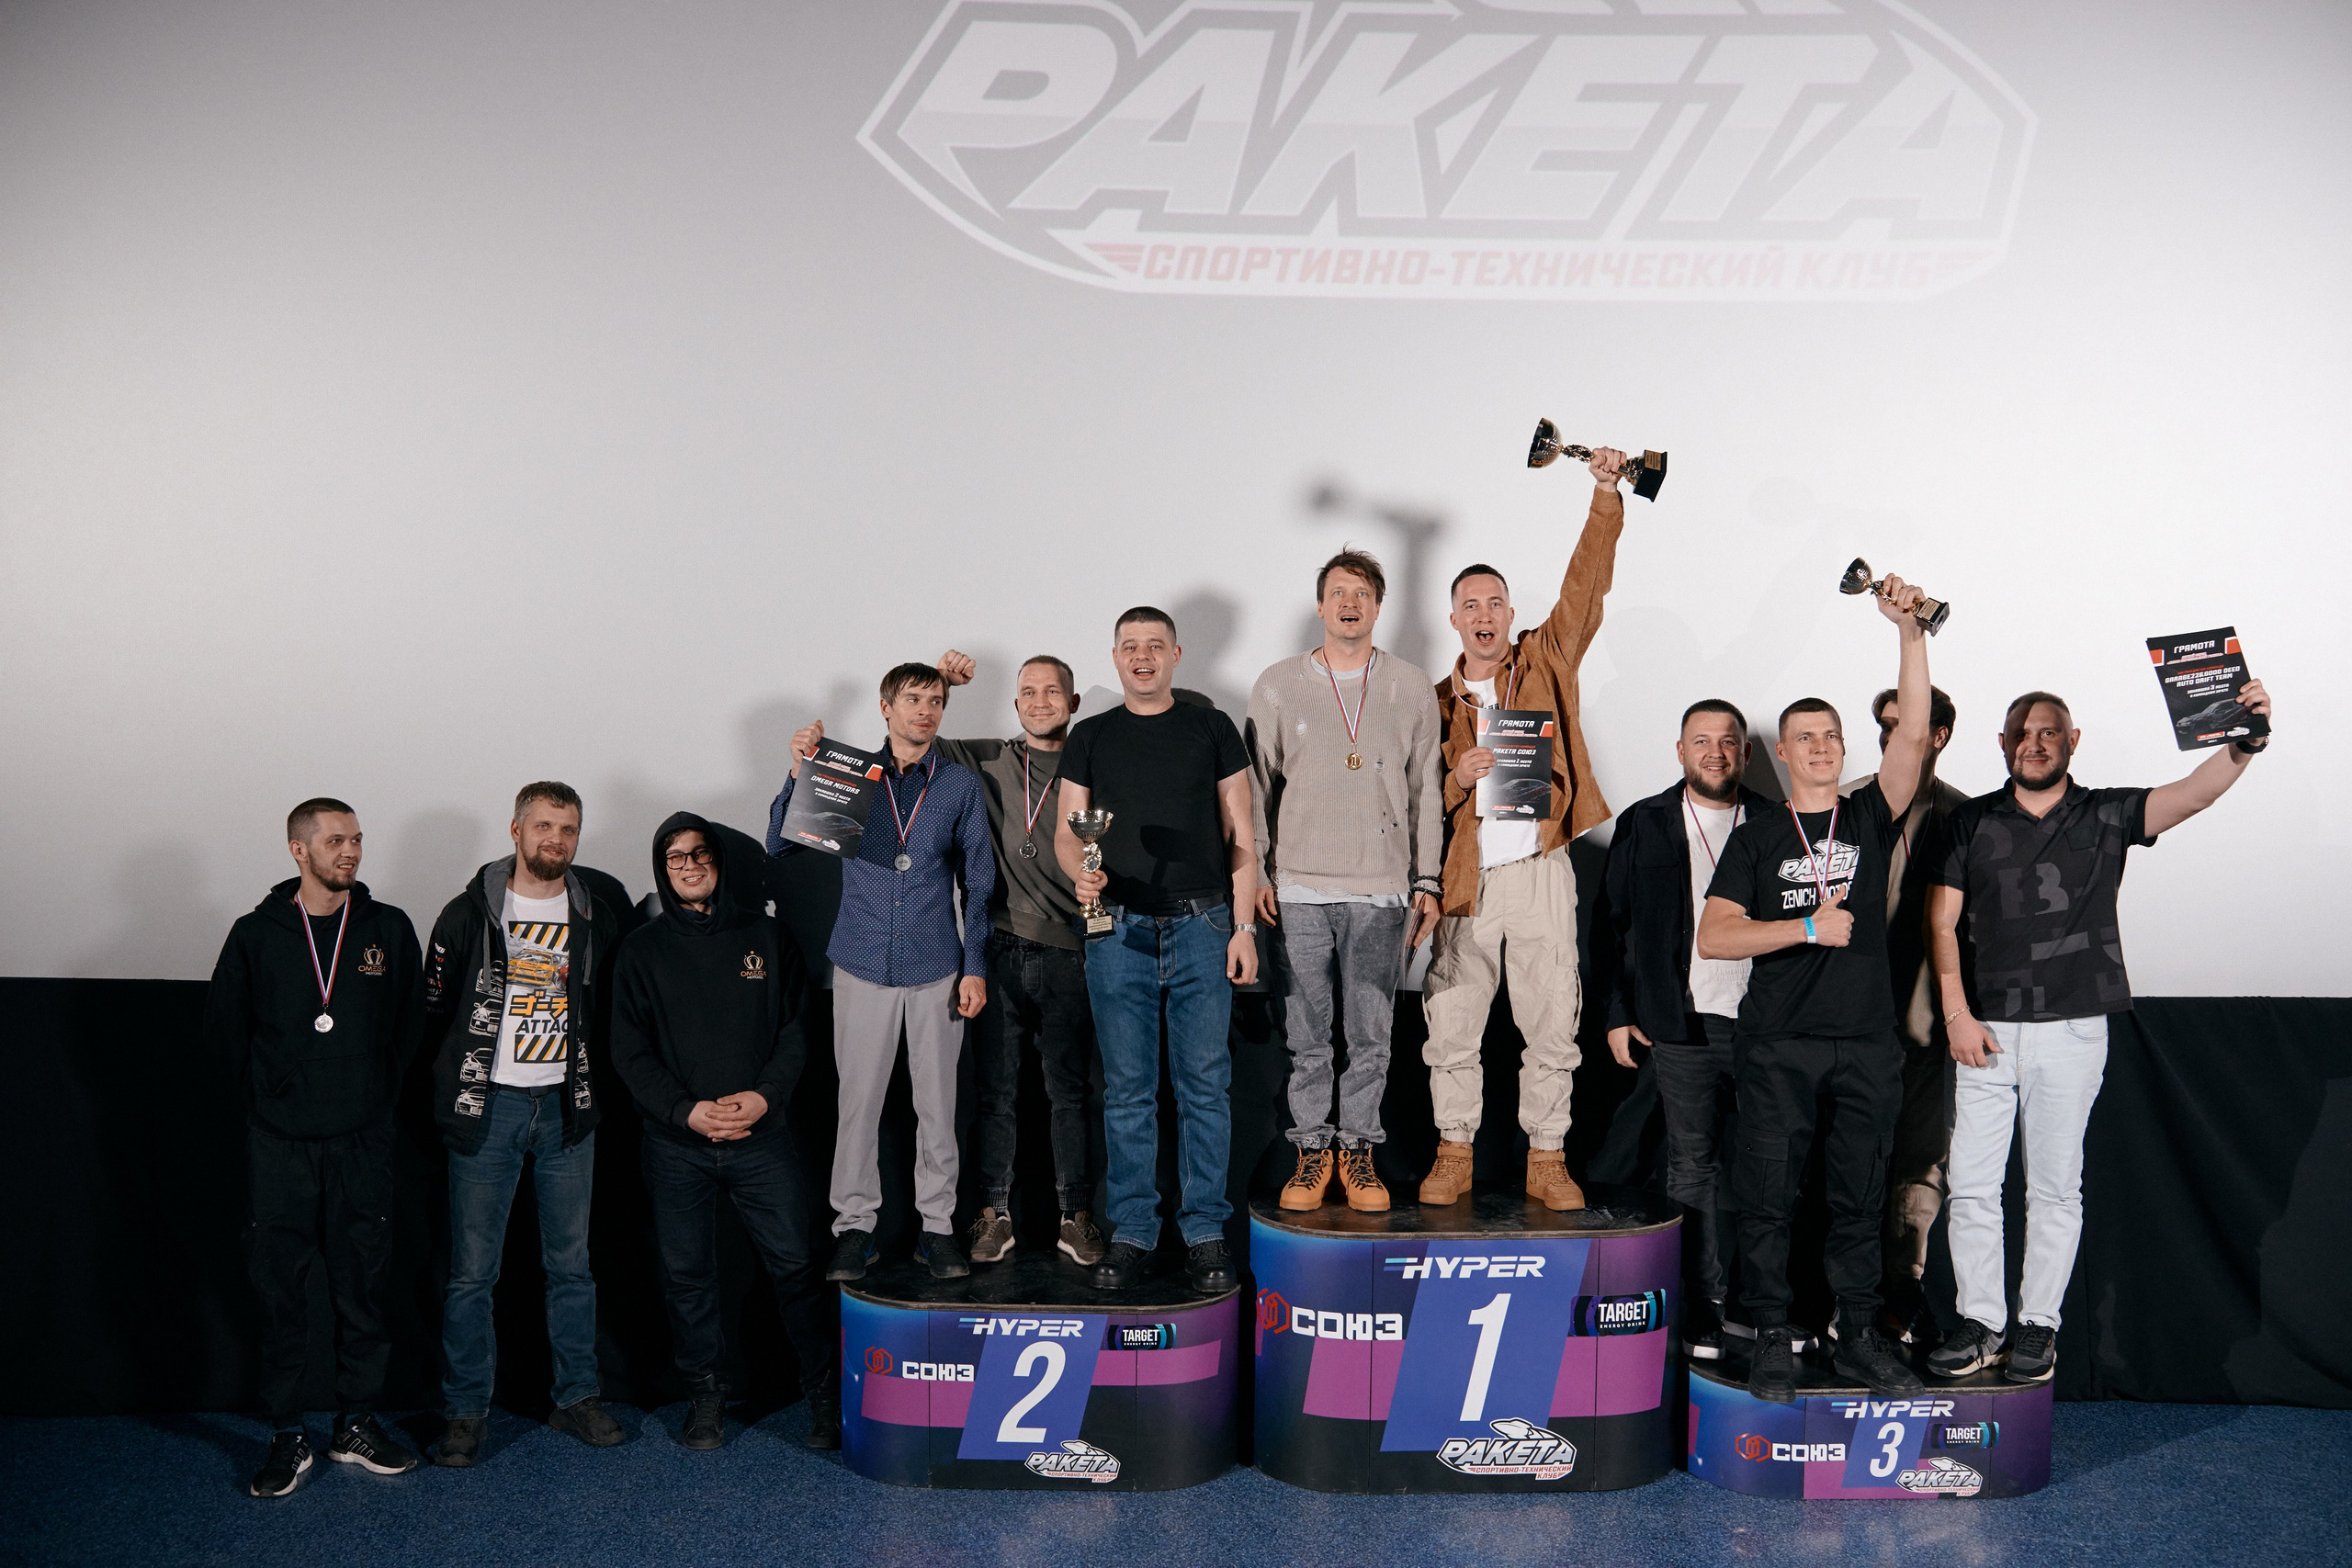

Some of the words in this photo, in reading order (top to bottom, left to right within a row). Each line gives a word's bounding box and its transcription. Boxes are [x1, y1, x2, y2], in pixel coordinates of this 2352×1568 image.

[896, 17, 2007, 223] РАКЕТА
[1144, 242, 1784, 291] СПОРТИВНО-ТЕХНИЧЕСКИЙ
[1795, 250, 1932, 291] КЛУБ
[2174, 640, 2215, 654] ГРАМОТА
[1498, 719, 1535, 728] ГРАМОТА
[826, 750, 864, 767] ГРАМОТА
[810, 775, 834, 786] OMEGA
[832, 782, 861, 795] MOTORS
[1780, 851, 1858, 878] РАКЕТ
[1781, 887, 1816, 910] ZENICH
[1395, 1256, 1546, 1280] HYPER
[1599, 1300, 1648, 1322] TARGET
[967, 1317, 1084, 1337] HYPER
[1292, 1305, 1403, 1341] СОЮЗ
[1123, 1329, 1159, 1342] TARGET
[1459, 1292, 1511, 1422] 1
[902, 1360, 975, 1382] СОЮЗ
[996, 1340, 1067, 1443] 2
[1839, 1400, 1955, 1418] HYPER
[1945, 1427, 1982, 1440] TARGET
[1439, 1439, 1574, 1465] РАКЕТА
[1771, 1443, 1847, 1461] СОЮЗ
[1870, 1421, 1905, 1478] 3
[1026, 1453, 1118, 1472] РАКЕТА
[1476, 1465, 1572, 1473] СПОРТИВНО-ТЕХНИЧЕСКИЙ
[1898, 1471, 1981, 1487] РАКЕТА
